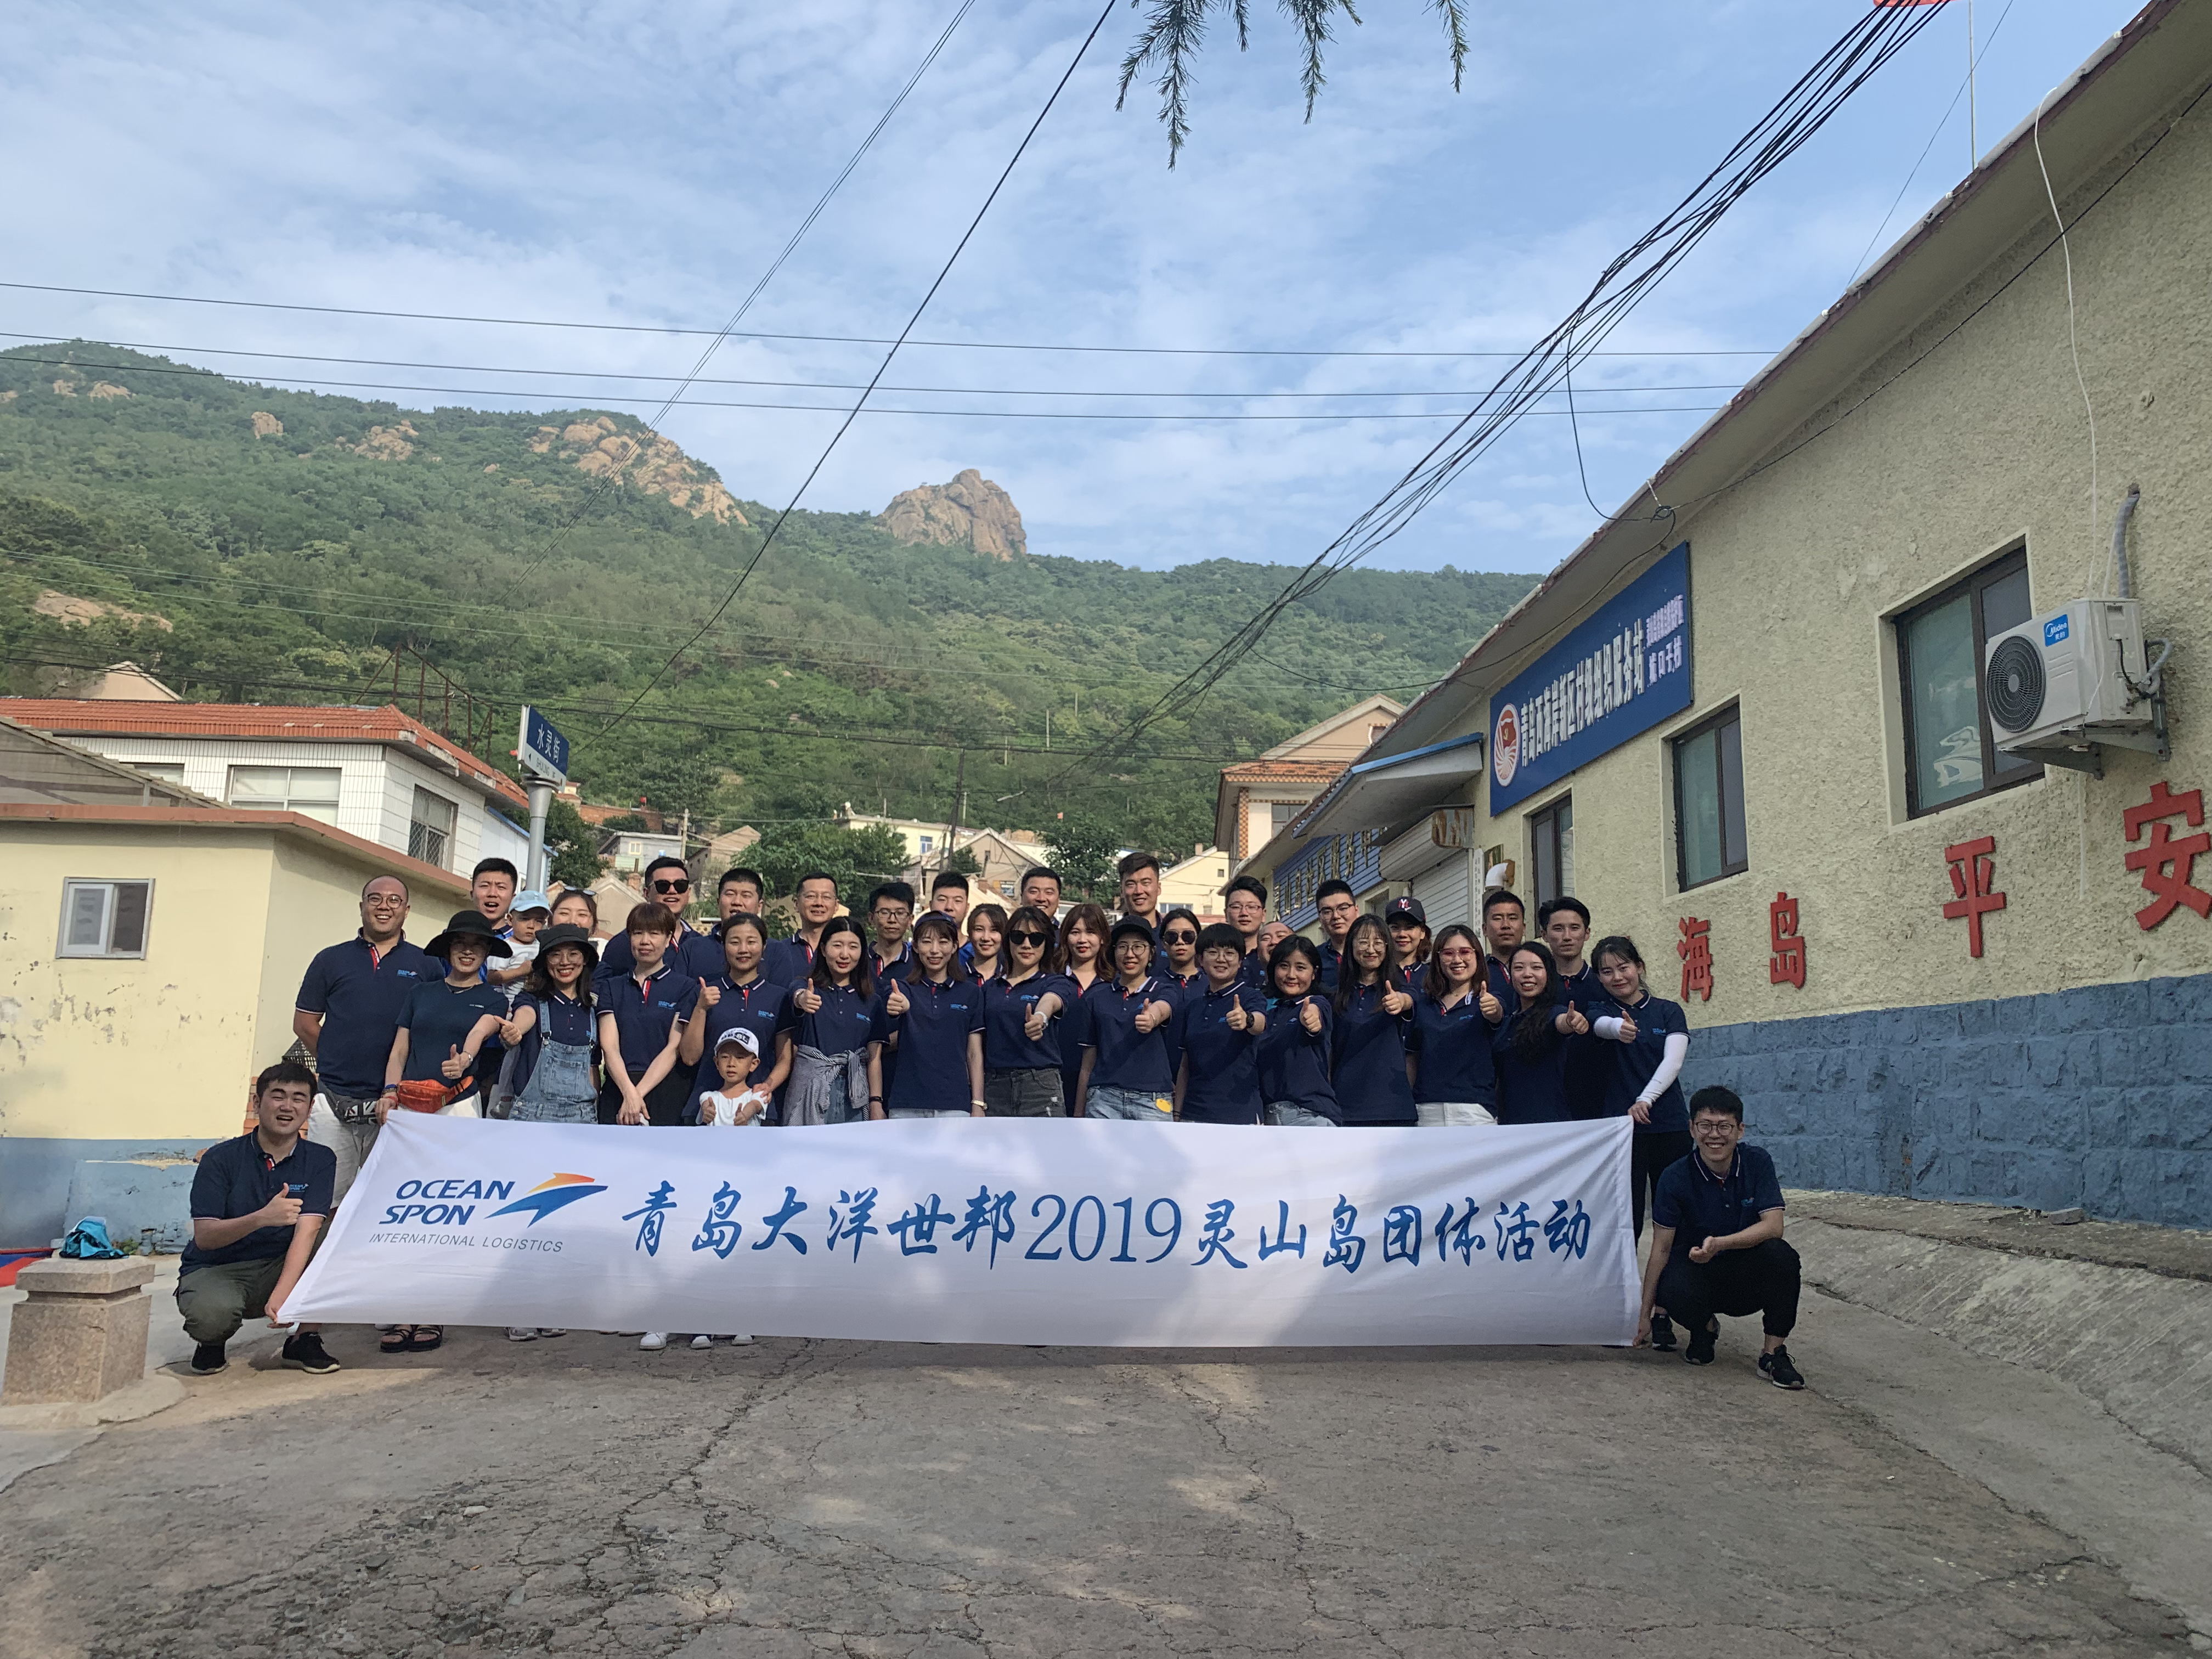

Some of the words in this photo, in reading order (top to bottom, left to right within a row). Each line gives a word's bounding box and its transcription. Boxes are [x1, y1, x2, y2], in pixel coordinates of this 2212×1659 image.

[2046, 622, 2067, 637] Midea
[1677, 781, 2212, 1002] 海岛平安
[396, 1180, 515, 1200] OCEAN
[379, 1205, 476, 1225] SPON
[622, 1180, 1592, 1274] 青岛大洋世邦2019灵山岛团体活动
[369, 1233, 475, 1246] INTERNATIONAL
[482, 1237, 563, 1252] LOGISTICS
